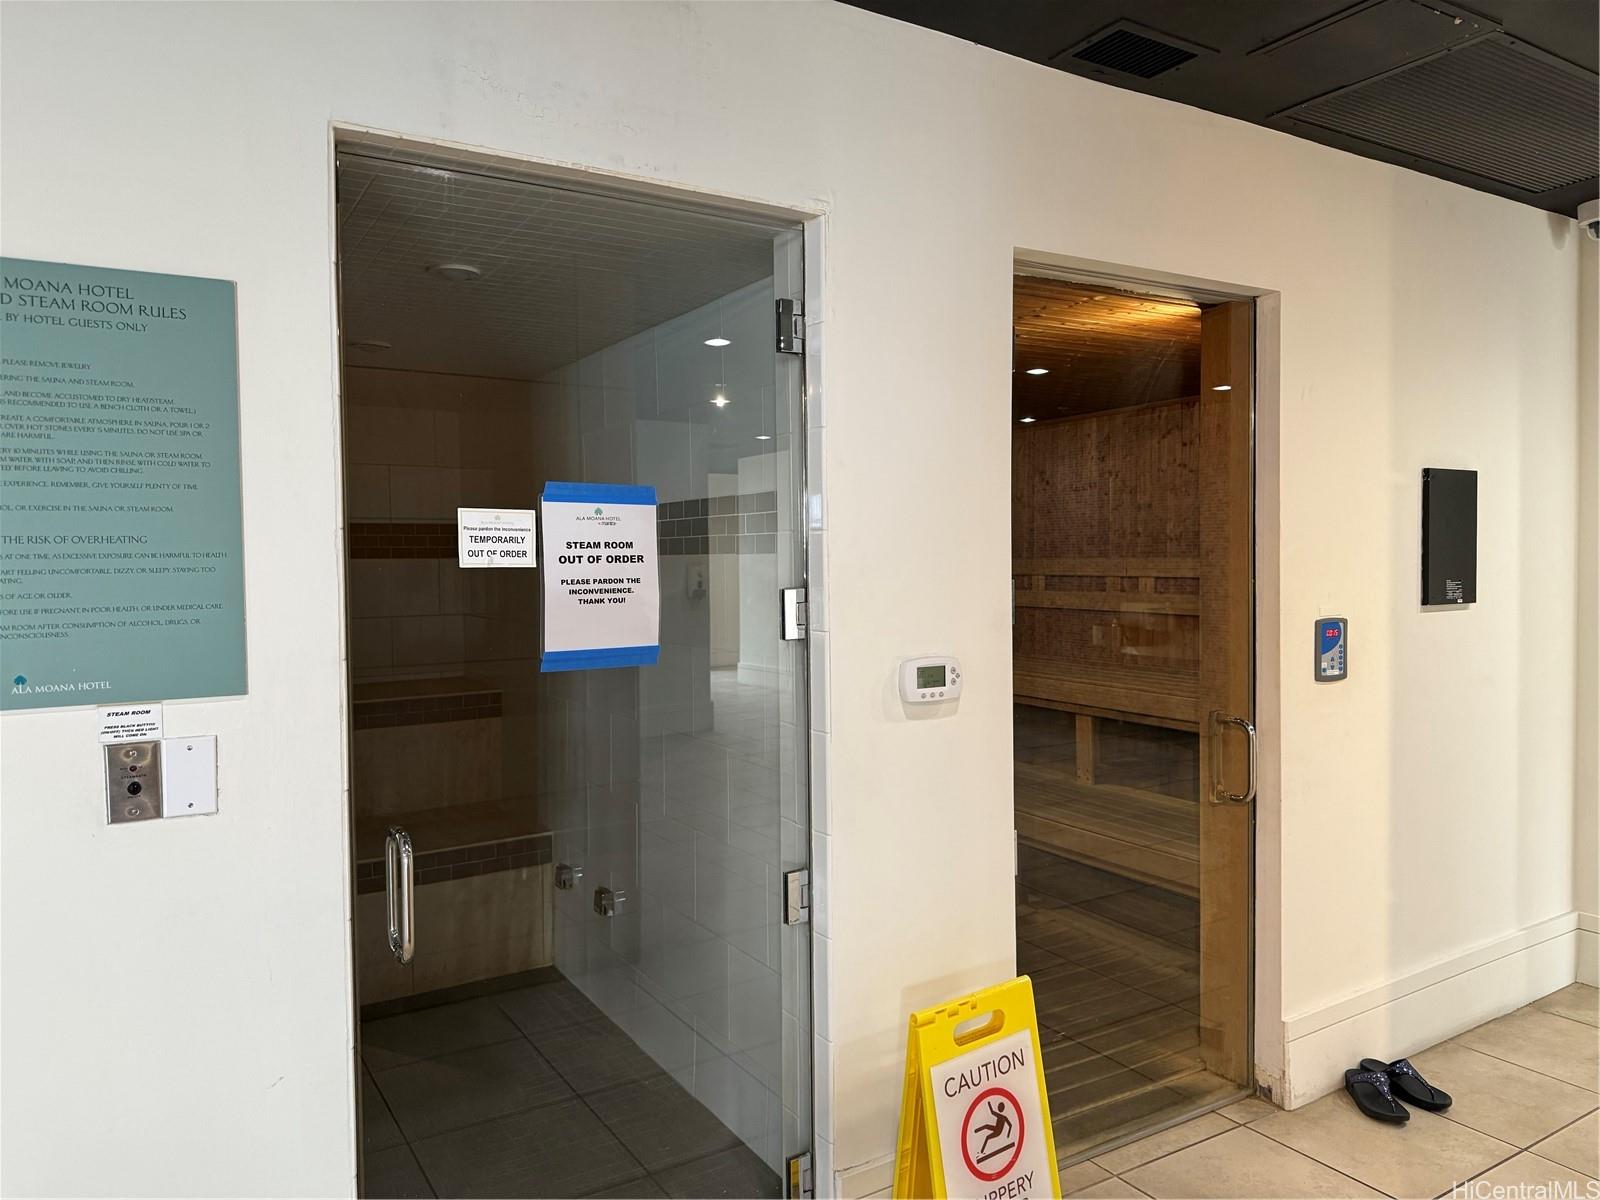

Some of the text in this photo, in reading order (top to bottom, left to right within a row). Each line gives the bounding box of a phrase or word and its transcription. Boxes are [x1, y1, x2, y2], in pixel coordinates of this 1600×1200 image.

[4, 276, 134, 300] MOANA HOTEL
[18, 294, 75, 310] STEAM
[81, 300, 133, 316] ROOM
[139, 305, 187, 320] RULES
[6, 312, 149, 332] BY HOTEL GUESTS ONLY
[25, 375, 39, 383] THE
[41, 376, 67, 384] SAUNA
[4, 390, 21, 399] AND
[67, 401, 78, 409] TO
[44, 425, 72, 433] STONES
[15, 504, 27, 512] OR
[126, 505, 150, 513] STEAM
[1, 535, 148, 545] THE RISK OF OVERHEATING
[469, 535, 526, 545] TEMPORARILY
[566, 541, 634, 549] STEAM ROOM
[467, 549, 528, 559] OUT OF ORDER
[558, 555, 645, 564] OUT OF ORDER
[560, 578, 591, 586] PLEASE
[568, 587, 635, 596] INCONVENIENCE.
[578, 596, 626, 605] THANK YOU!
[37, 623, 60, 631] AFTER
[190, 617, 201, 625] OR
[11, 681, 112, 696] ALA MOANA HOTEL
[944, 1047, 1025, 1098] CAUTION
